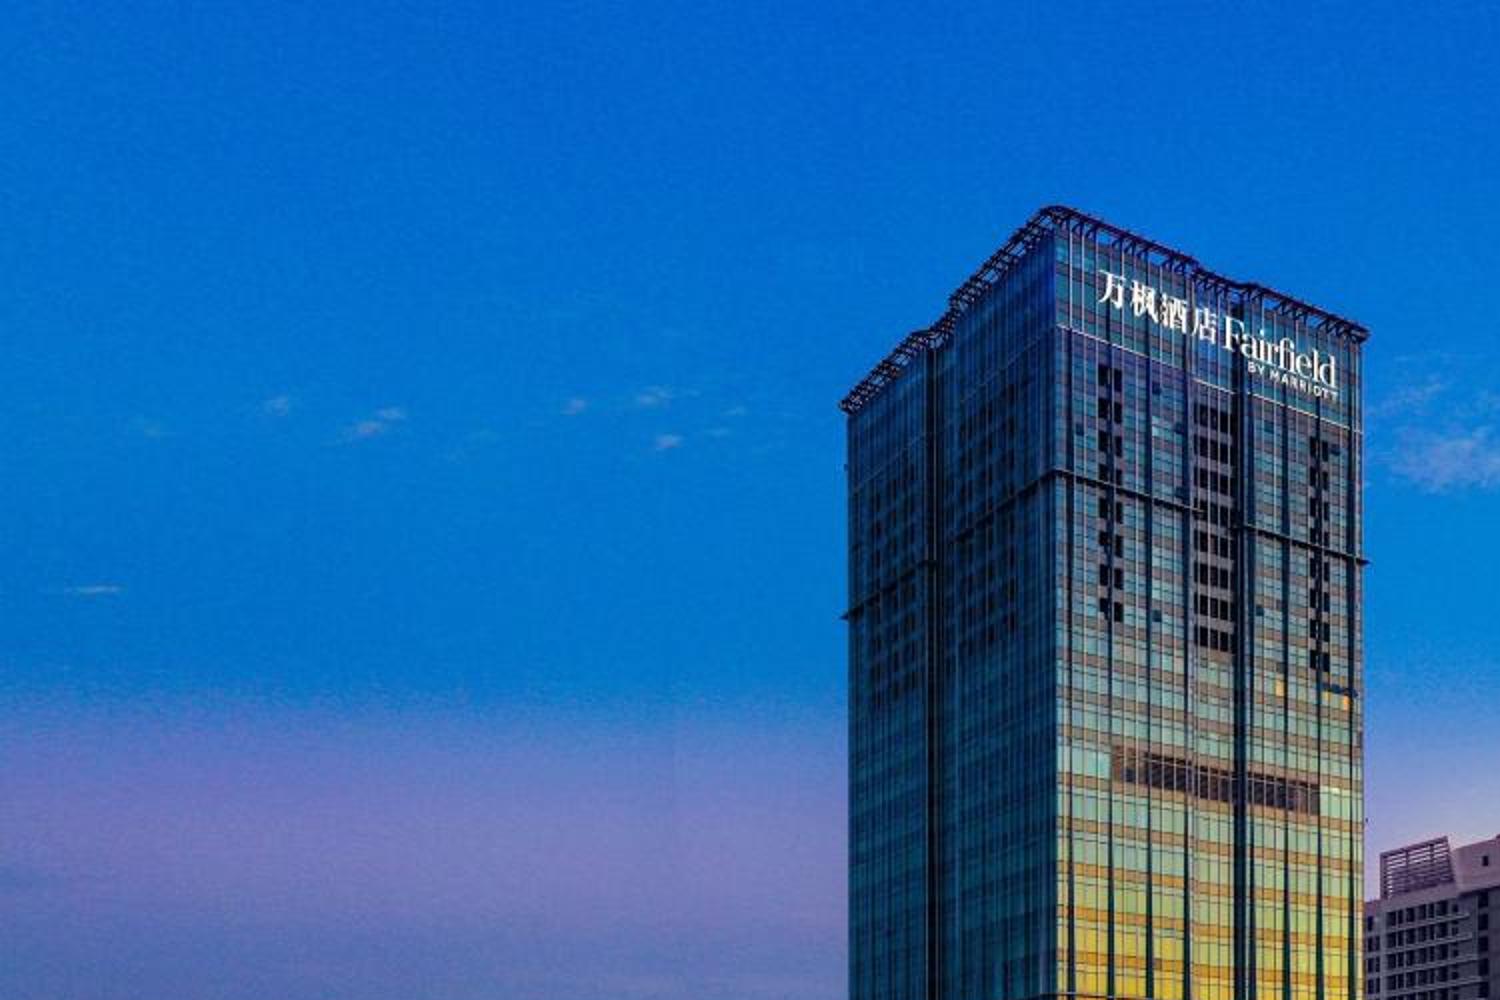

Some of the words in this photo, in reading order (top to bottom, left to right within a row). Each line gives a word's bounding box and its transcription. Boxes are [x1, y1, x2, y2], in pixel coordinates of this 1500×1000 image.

[1099, 269, 1217, 344] 万枫酒店
[1222, 316, 1337, 389] Fairfield
[1247, 361, 1265, 375] BY
[1269, 370, 1338, 401] MARRIOTT
